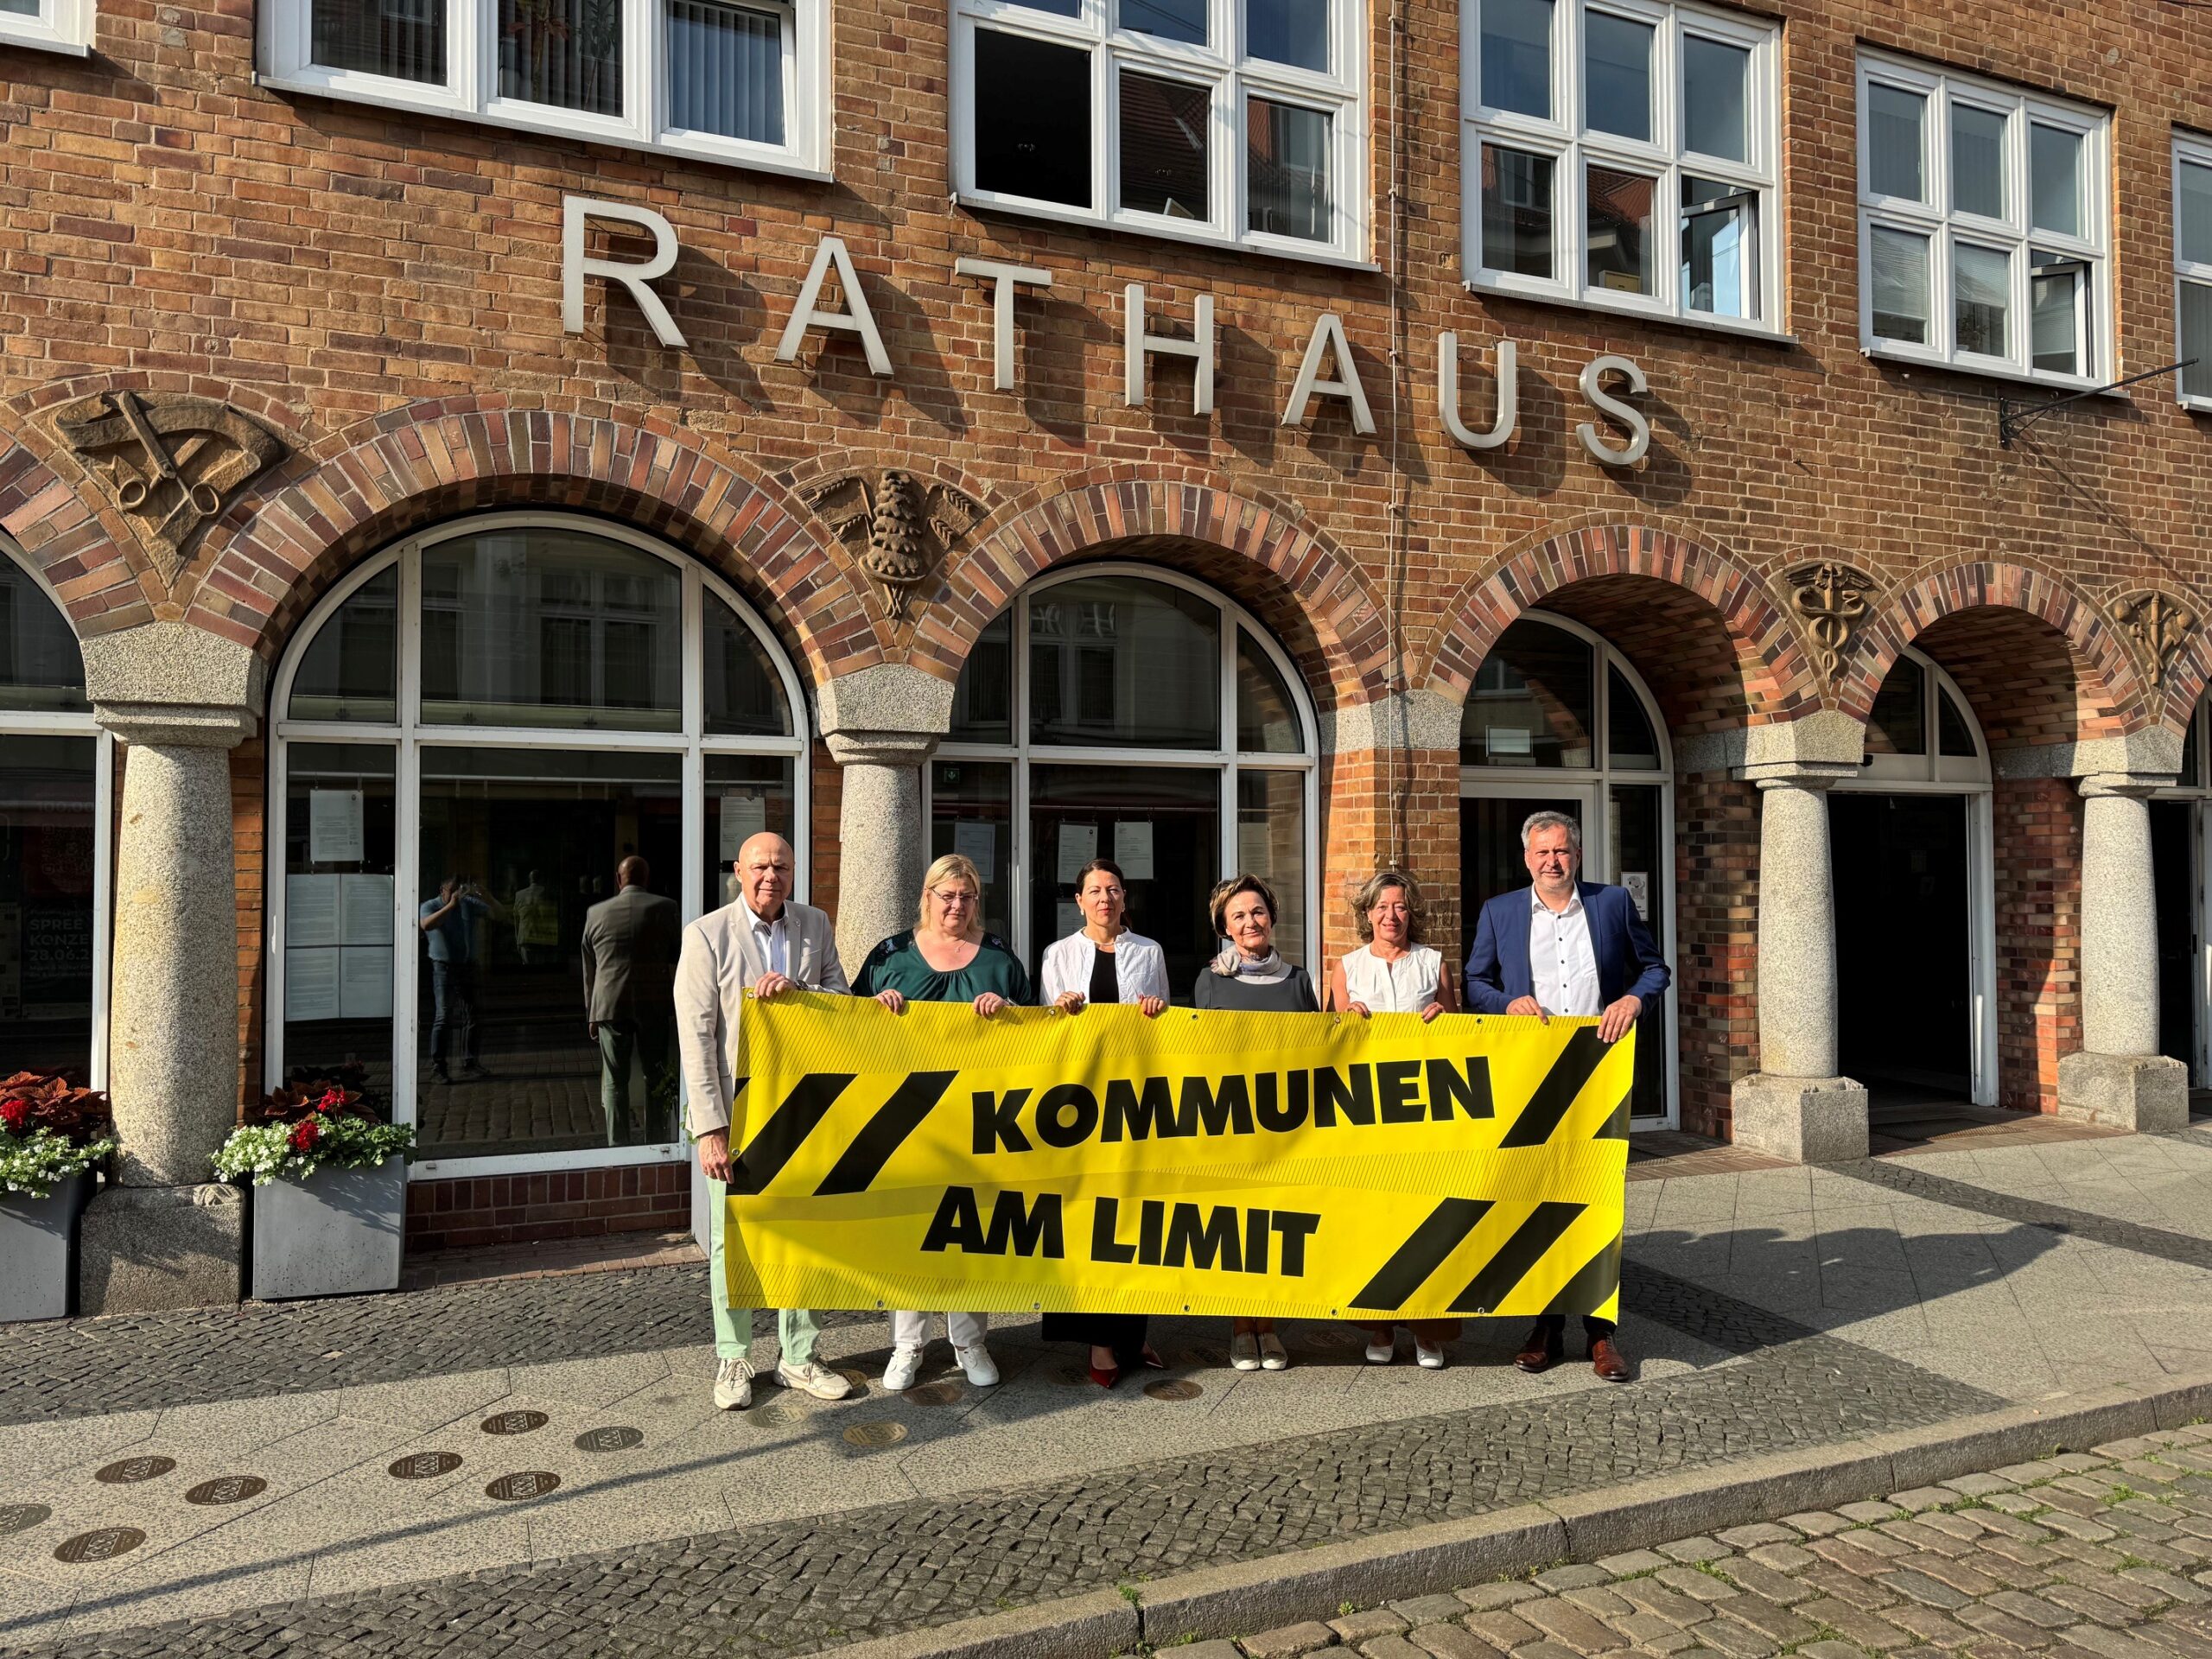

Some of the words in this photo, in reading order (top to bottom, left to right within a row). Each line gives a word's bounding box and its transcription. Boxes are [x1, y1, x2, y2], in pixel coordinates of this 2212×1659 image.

[563, 194, 1649, 466] RATHAUS
[29, 918, 84, 931] SPREE
[29, 934, 92, 946] KONZE
[29, 949, 90, 961] 28.06.2
[971, 1056, 1496, 1154] KOMMUNEN
[919, 1185, 1065, 1259] AM
[1090, 1196, 1322, 1278] LIMIT
